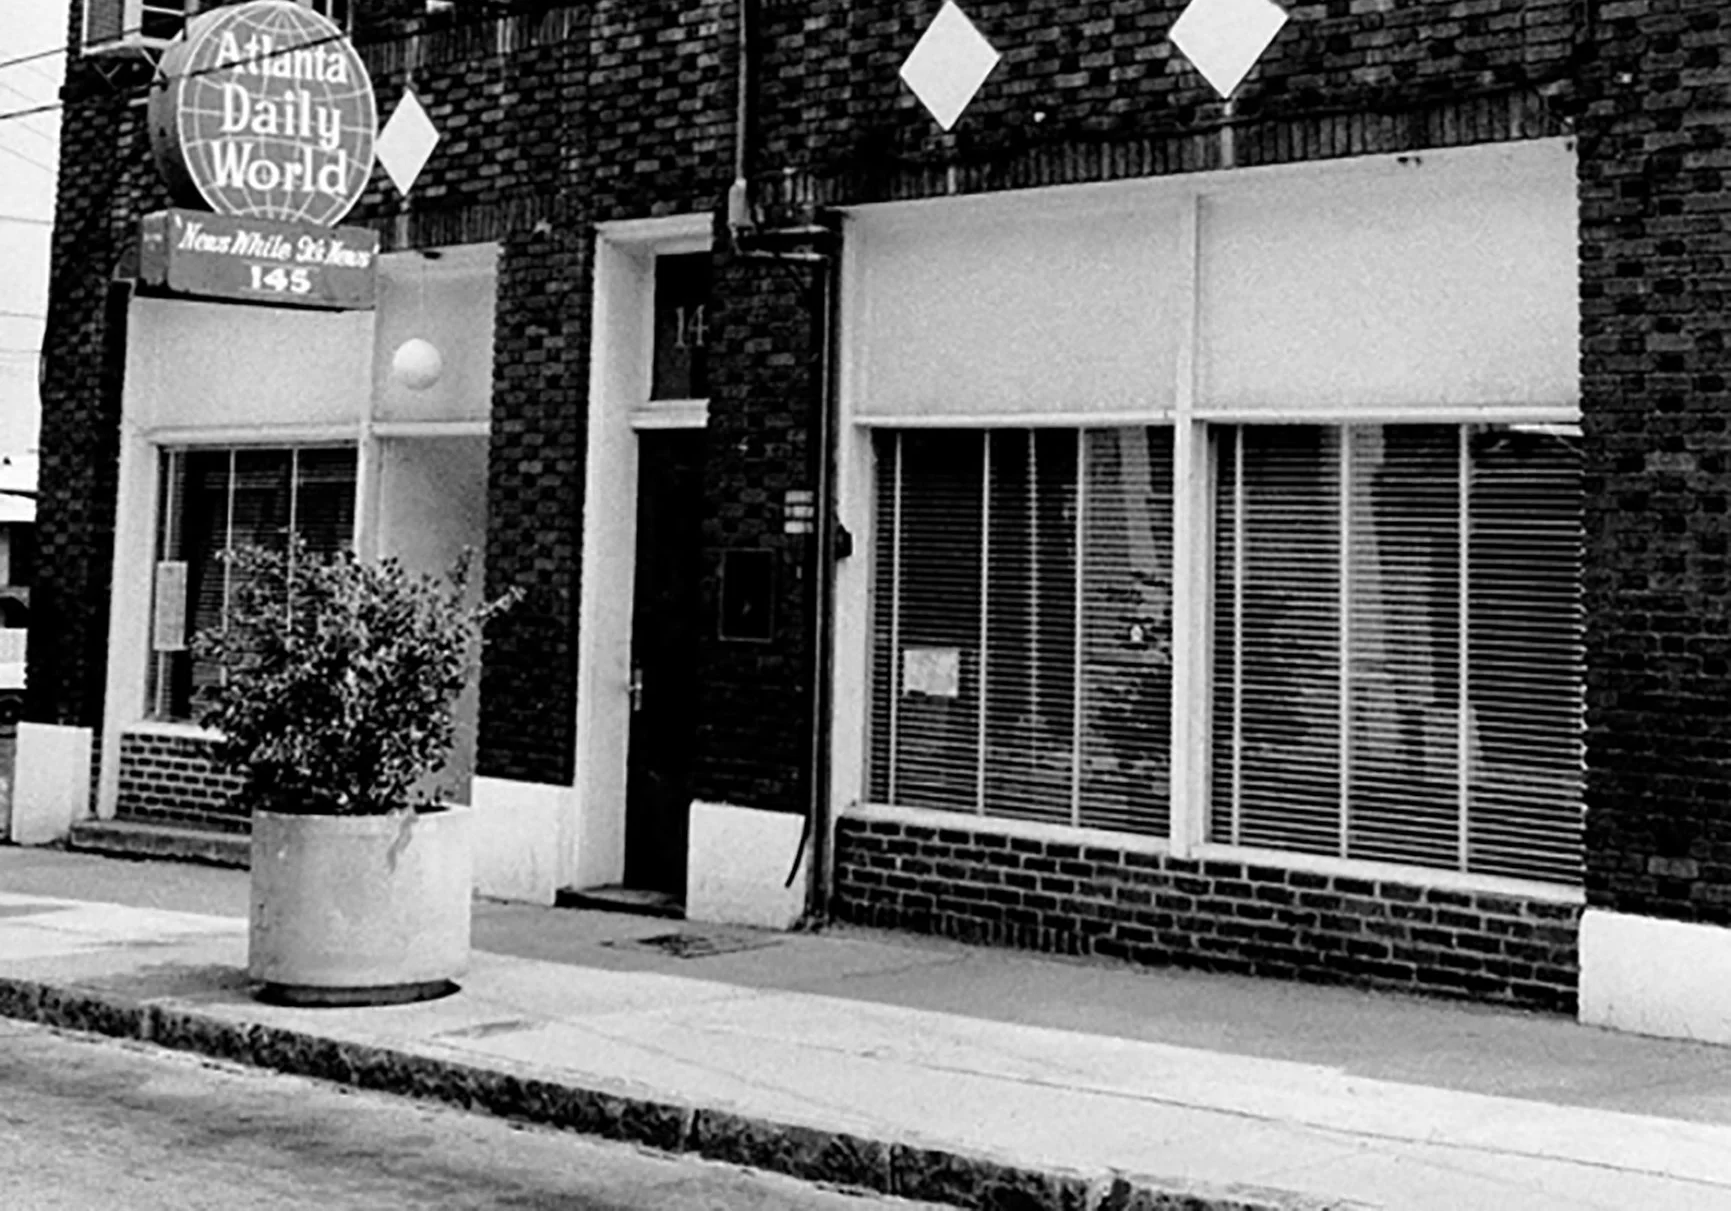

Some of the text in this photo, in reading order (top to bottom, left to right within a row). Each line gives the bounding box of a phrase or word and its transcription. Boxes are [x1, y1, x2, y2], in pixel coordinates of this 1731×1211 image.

[215, 30, 348, 83] Atlanta
[220, 82, 341, 149] Daily
[211, 140, 348, 194] World
[251, 265, 312, 293] 145
